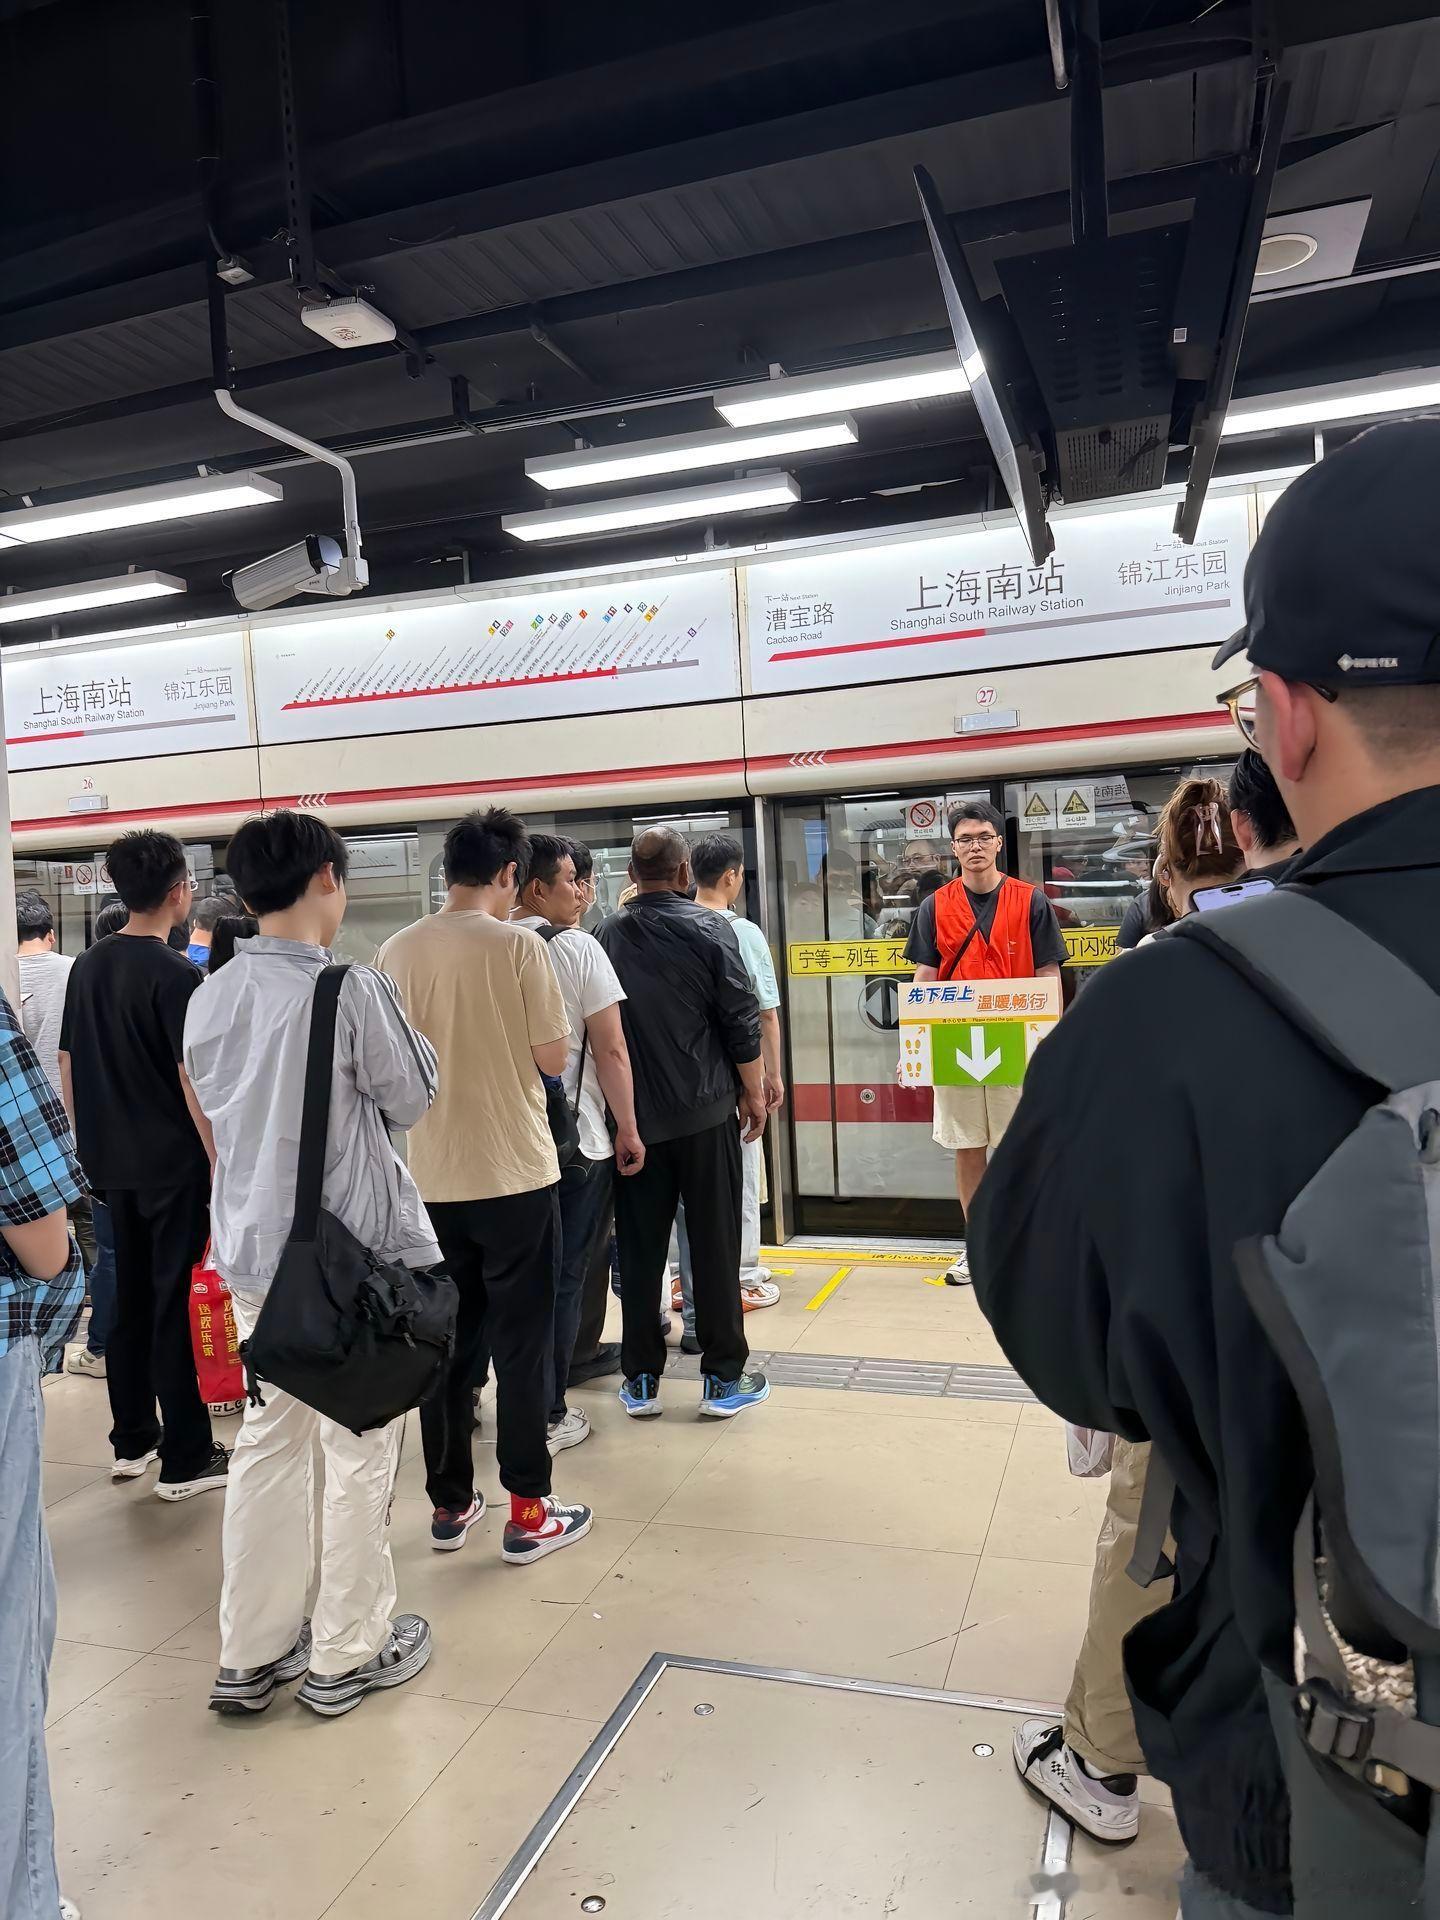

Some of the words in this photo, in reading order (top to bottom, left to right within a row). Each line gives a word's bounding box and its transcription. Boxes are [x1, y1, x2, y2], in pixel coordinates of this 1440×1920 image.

[1117, 550, 1227, 585] 锦江乐园
[906, 556, 1065, 612] 上海南站
[1164, 584, 1203, 596] Jinjiang
[1206, 580, 1231, 590] Park
[765, 593, 789, 604] 下一站
[766, 602, 834, 631] 漕宝路
[890, 613, 946, 631] Shanghai
[949, 609, 984, 623] South
[988, 604, 1037, 619] Railway
[1040, 597, 1084, 612] Station
[766, 635, 798, 645] Caobao
[800, 631, 822, 641] Road
[33, 676, 131, 715] 上海南站
[164, 676, 232, 701] 锦江乐园
[979, 689, 994, 703] 27
[23, 717, 59, 730] Shanghai
[61, 714, 83, 726] South
[85, 711, 115, 723] Railway
[117, 708, 145, 719] Station
[83, 779, 93, 790] 26
[799, 947, 879, 968] 宁等一列车
[908, 985, 975, 1004] 先下后上
[977, 992, 1047, 1012] 温暖畅行
[521, 1504, 539, 1520] 福
